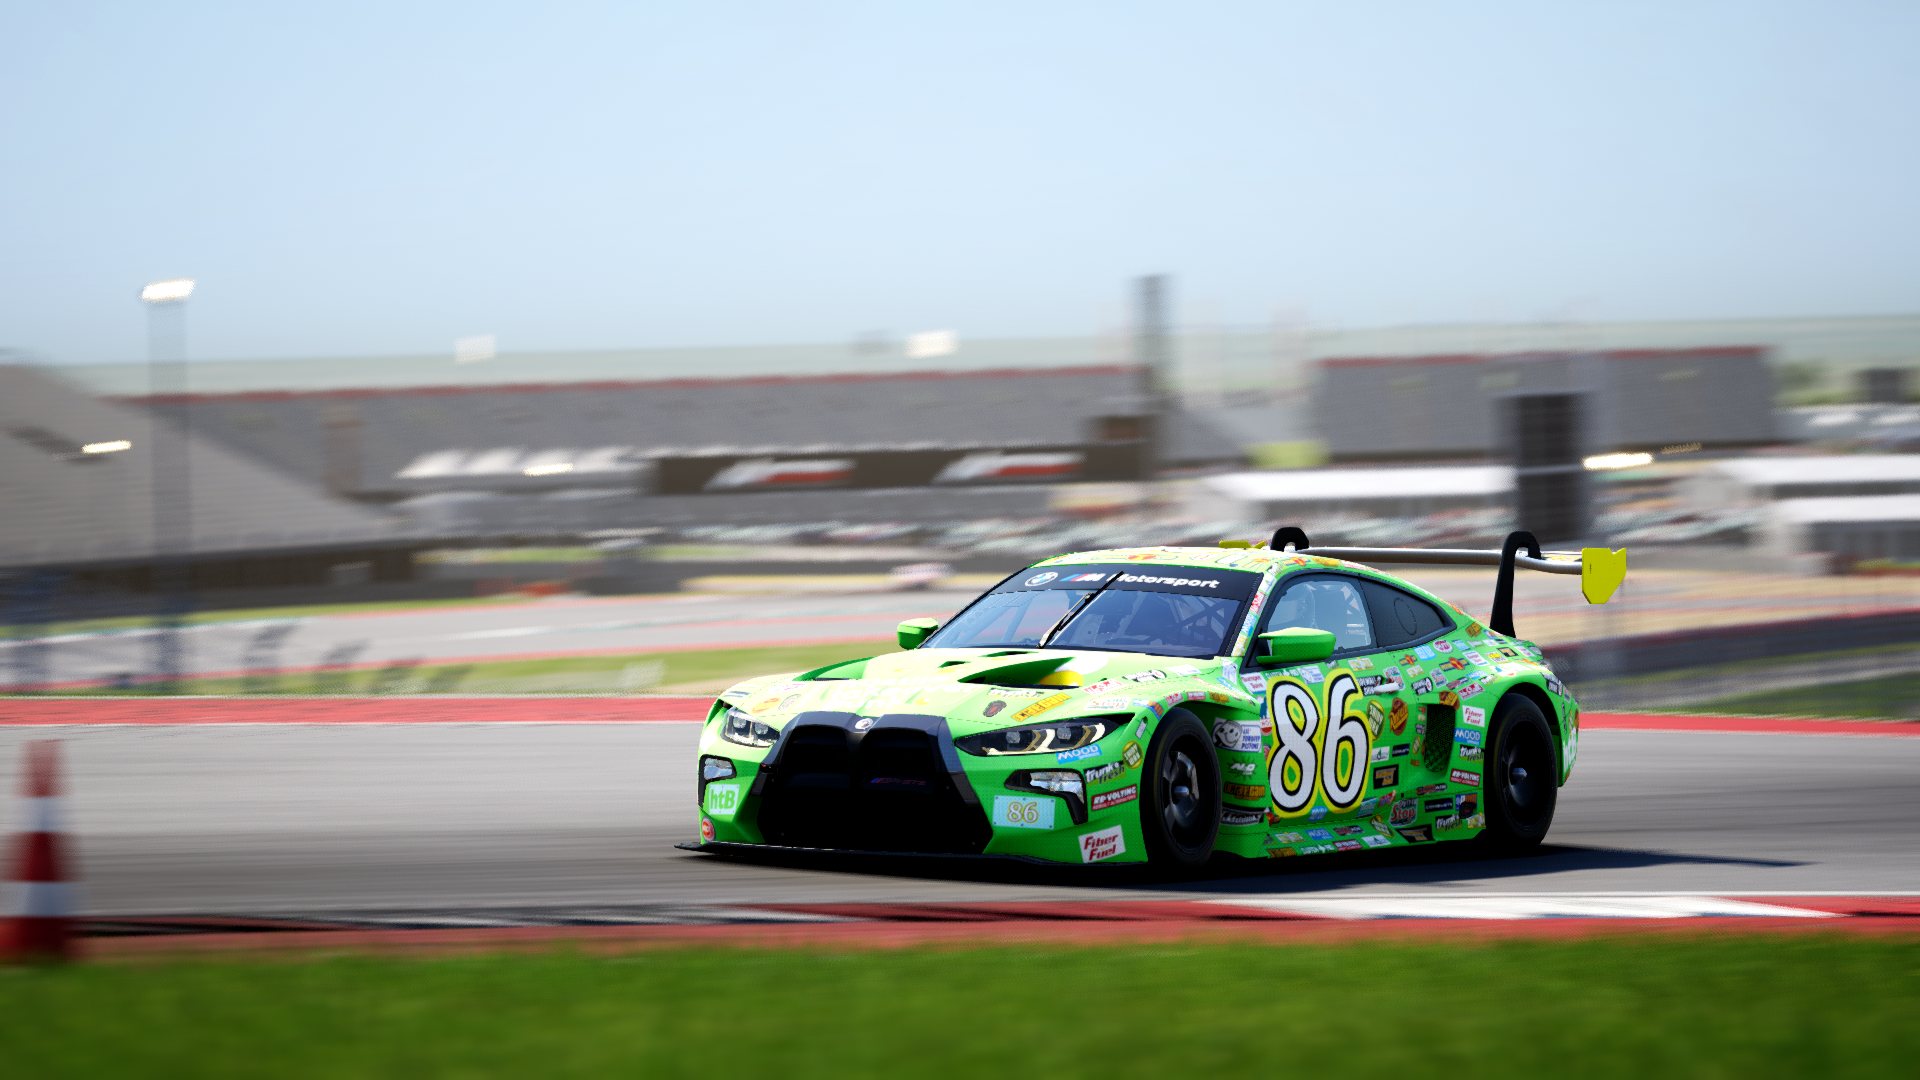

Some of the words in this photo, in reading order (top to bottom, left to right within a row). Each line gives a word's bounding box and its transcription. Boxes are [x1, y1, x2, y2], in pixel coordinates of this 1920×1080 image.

[1267, 671, 1372, 815] 86
[1455, 729, 1481, 741] MOOD
[1058, 744, 1099, 761] MOOD
[1098, 765, 1125, 785] fresh
[710, 789, 736, 810] htB
[1093, 786, 1137, 805] RE-VOLTING
[1007, 801, 1039, 823] 86
[1390, 803, 1415, 821] Stop
[1083, 834, 1119, 850] Fiber
[1088, 844, 1117, 861] Fuel
